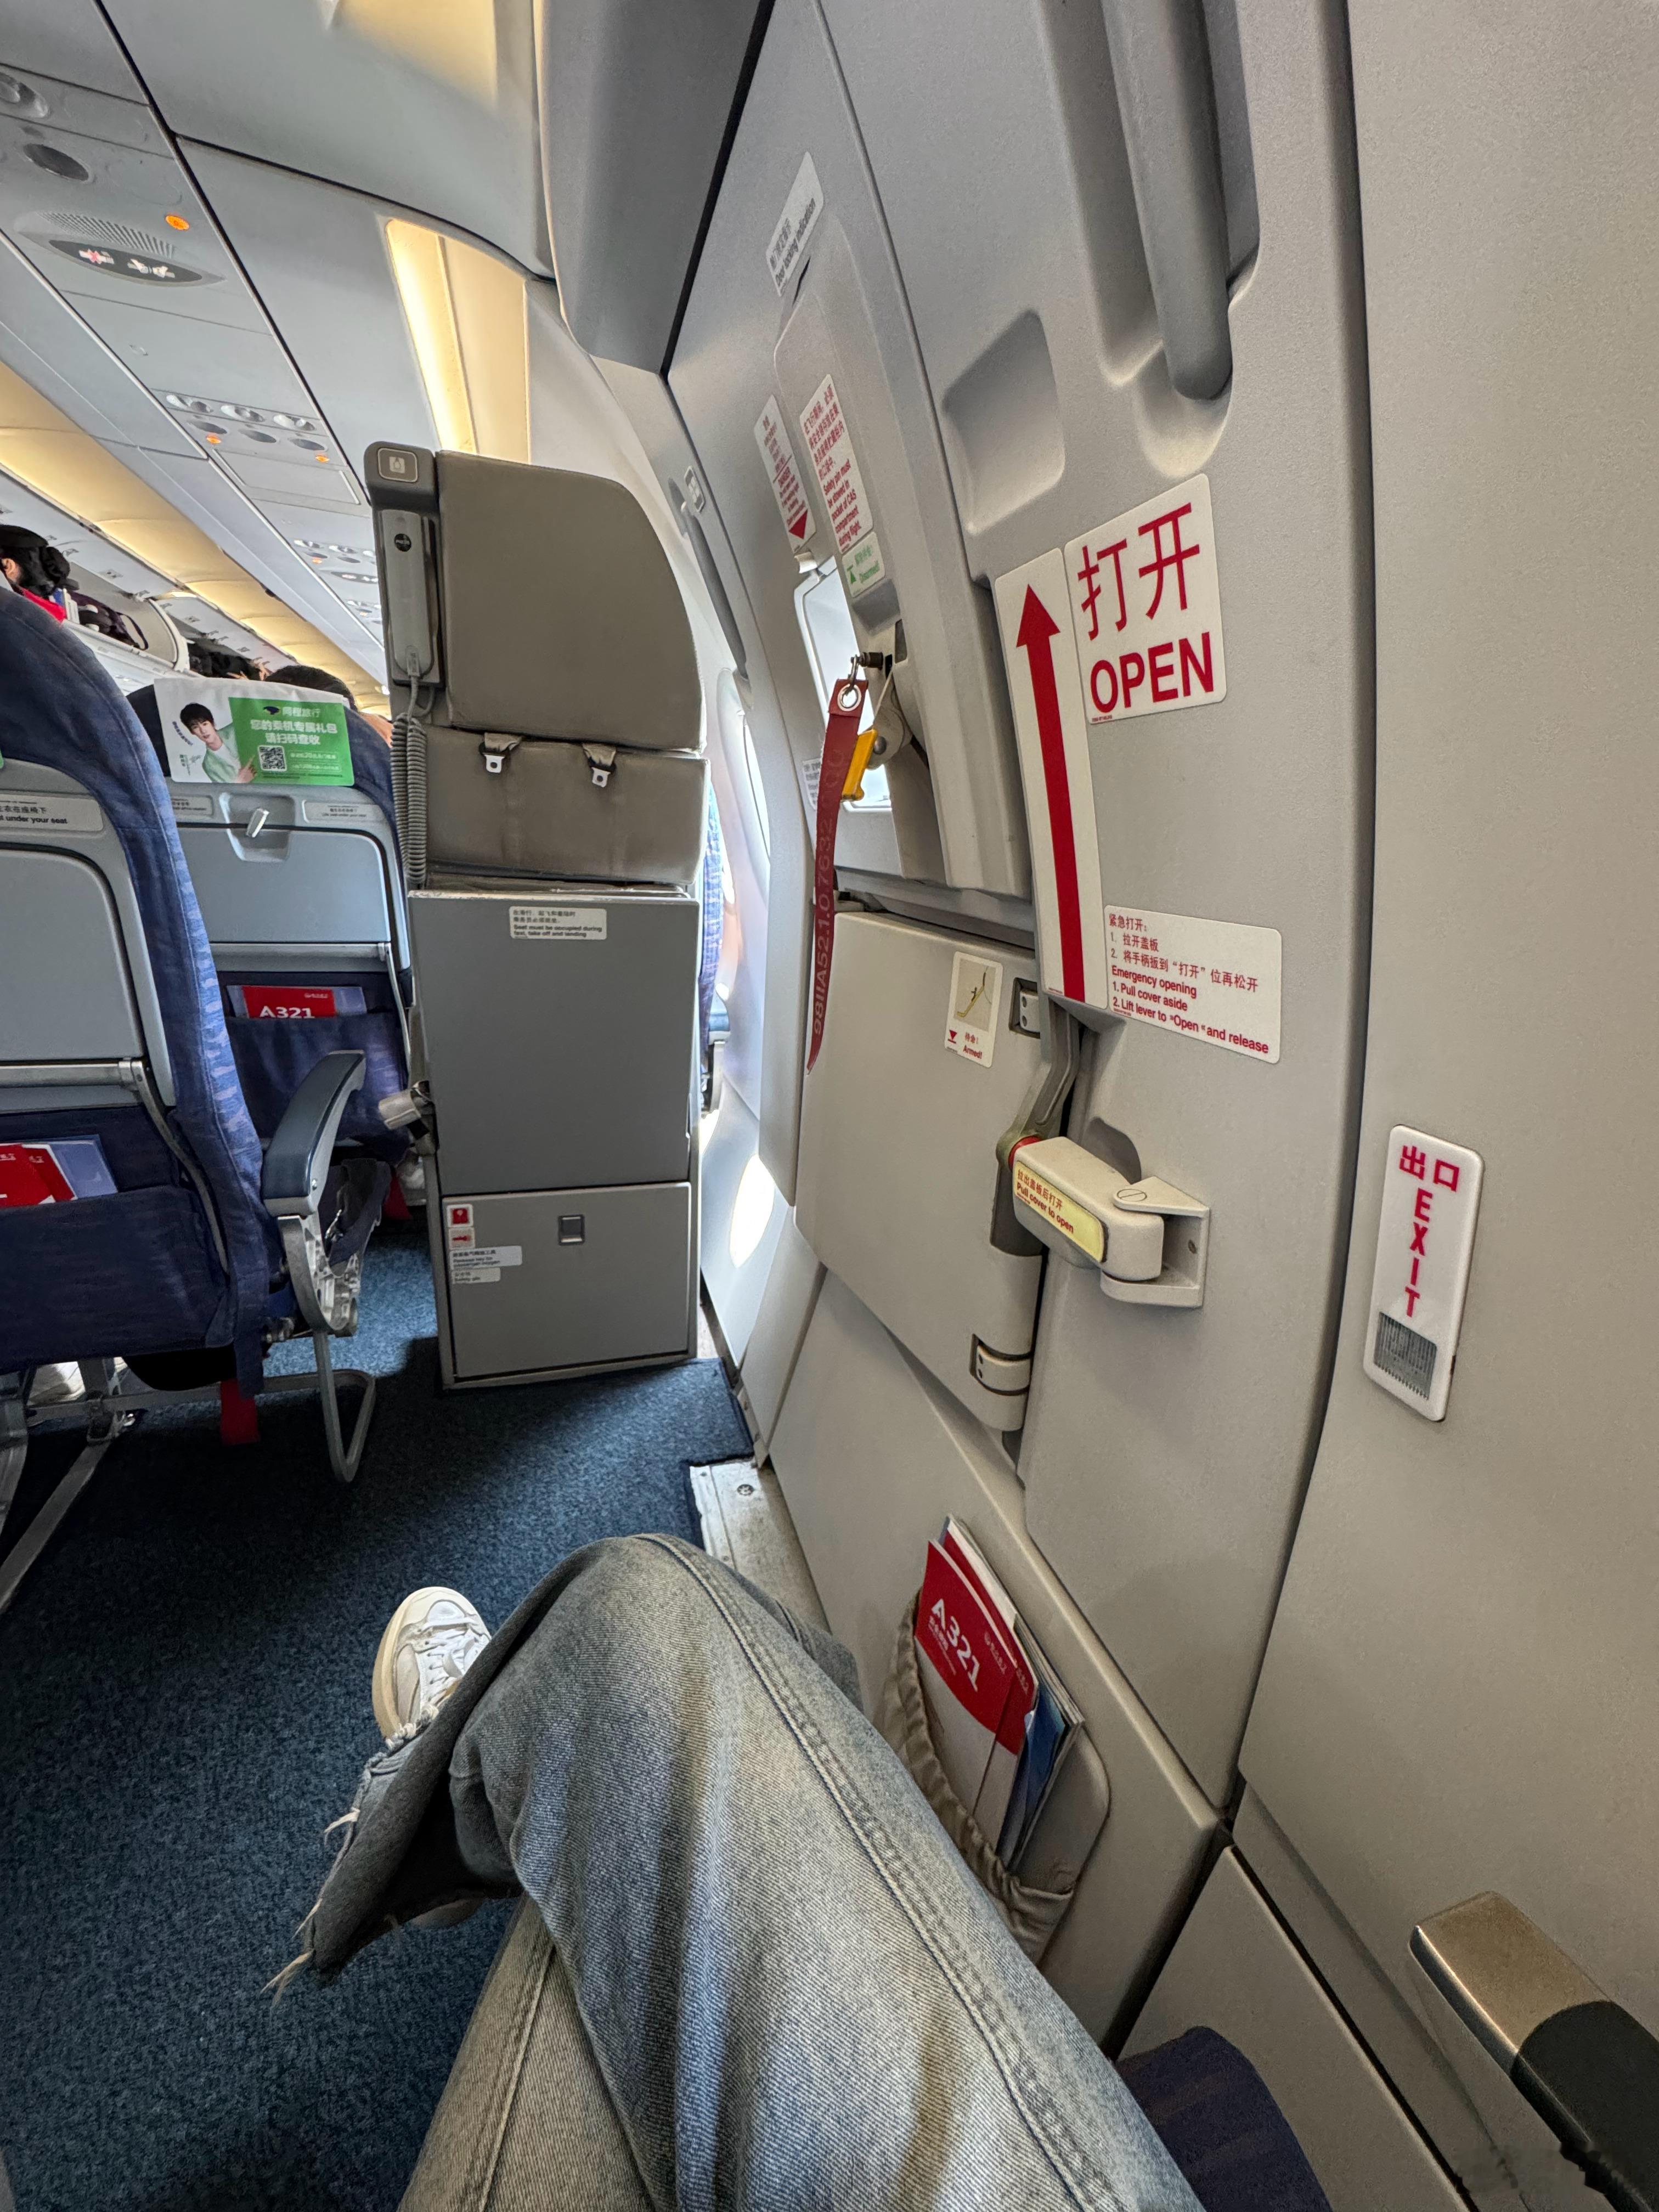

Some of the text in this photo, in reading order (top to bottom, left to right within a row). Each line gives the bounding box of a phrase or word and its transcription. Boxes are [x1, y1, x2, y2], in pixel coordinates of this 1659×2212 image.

[847, 489, 856, 505] CAS
[1077, 502, 1200, 640] 打开
[1091, 631, 1214, 713] OPEN
[266, 733, 320, 744] 请扫码查收
[1123, 933, 1159, 952] 拉开盖板
[1111, 965, 1197, 999] Emergency opening
[1113, 981, 1188, 1011] 1. Pull cover aside
[259, 1006, 315, 1018] A321
[1113, 997, 1120, 1007] 2.
[1121, 999, 1134, 1012] Lift
[1136, 1003, 1155, 1019] lever
[1158, 1012, 1166, 1022] to
[1207, 1026, 1226, 1040] and
[1229, 1033, 1268, 1054] release
[1400, 1146, 1460, 1192] 出口
[1017, 1184, 1028, 1198] Pull
[1029, 1194, 1047, 1211] cover
[1057, 1216, 1074, 1234] open
[1405, 1188, 1433, 1317] EXIT
[932, 1599, 980, 1692] A321
